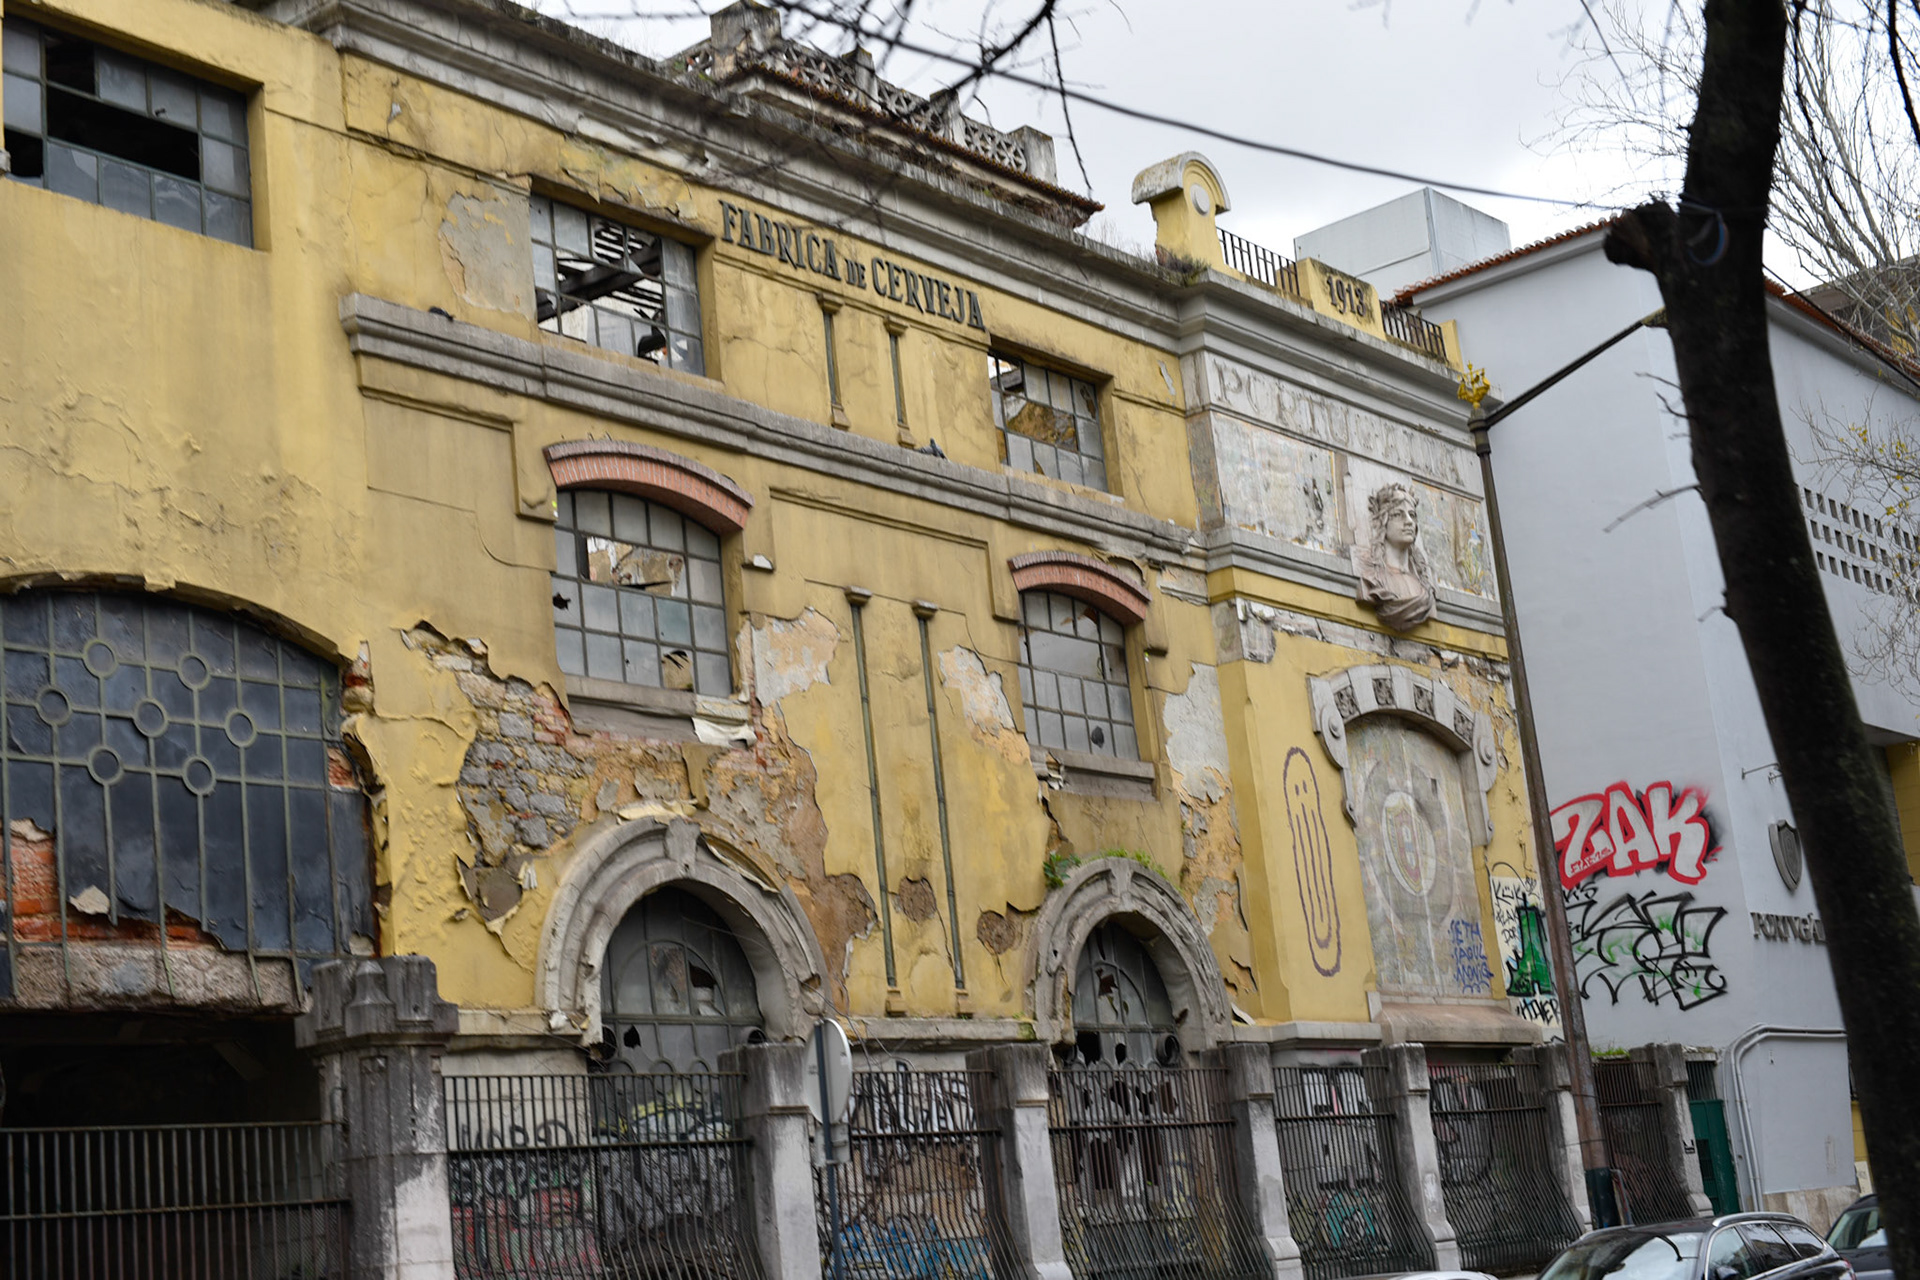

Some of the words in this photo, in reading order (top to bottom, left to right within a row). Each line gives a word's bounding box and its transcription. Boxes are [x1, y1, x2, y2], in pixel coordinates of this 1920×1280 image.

[719, 200, 842, 282] FABRICA
[845, 259, 867, 290] DE
[871, 257, 986, 332] CERVEJA
[1326, 276, 1367, 318] 1913
